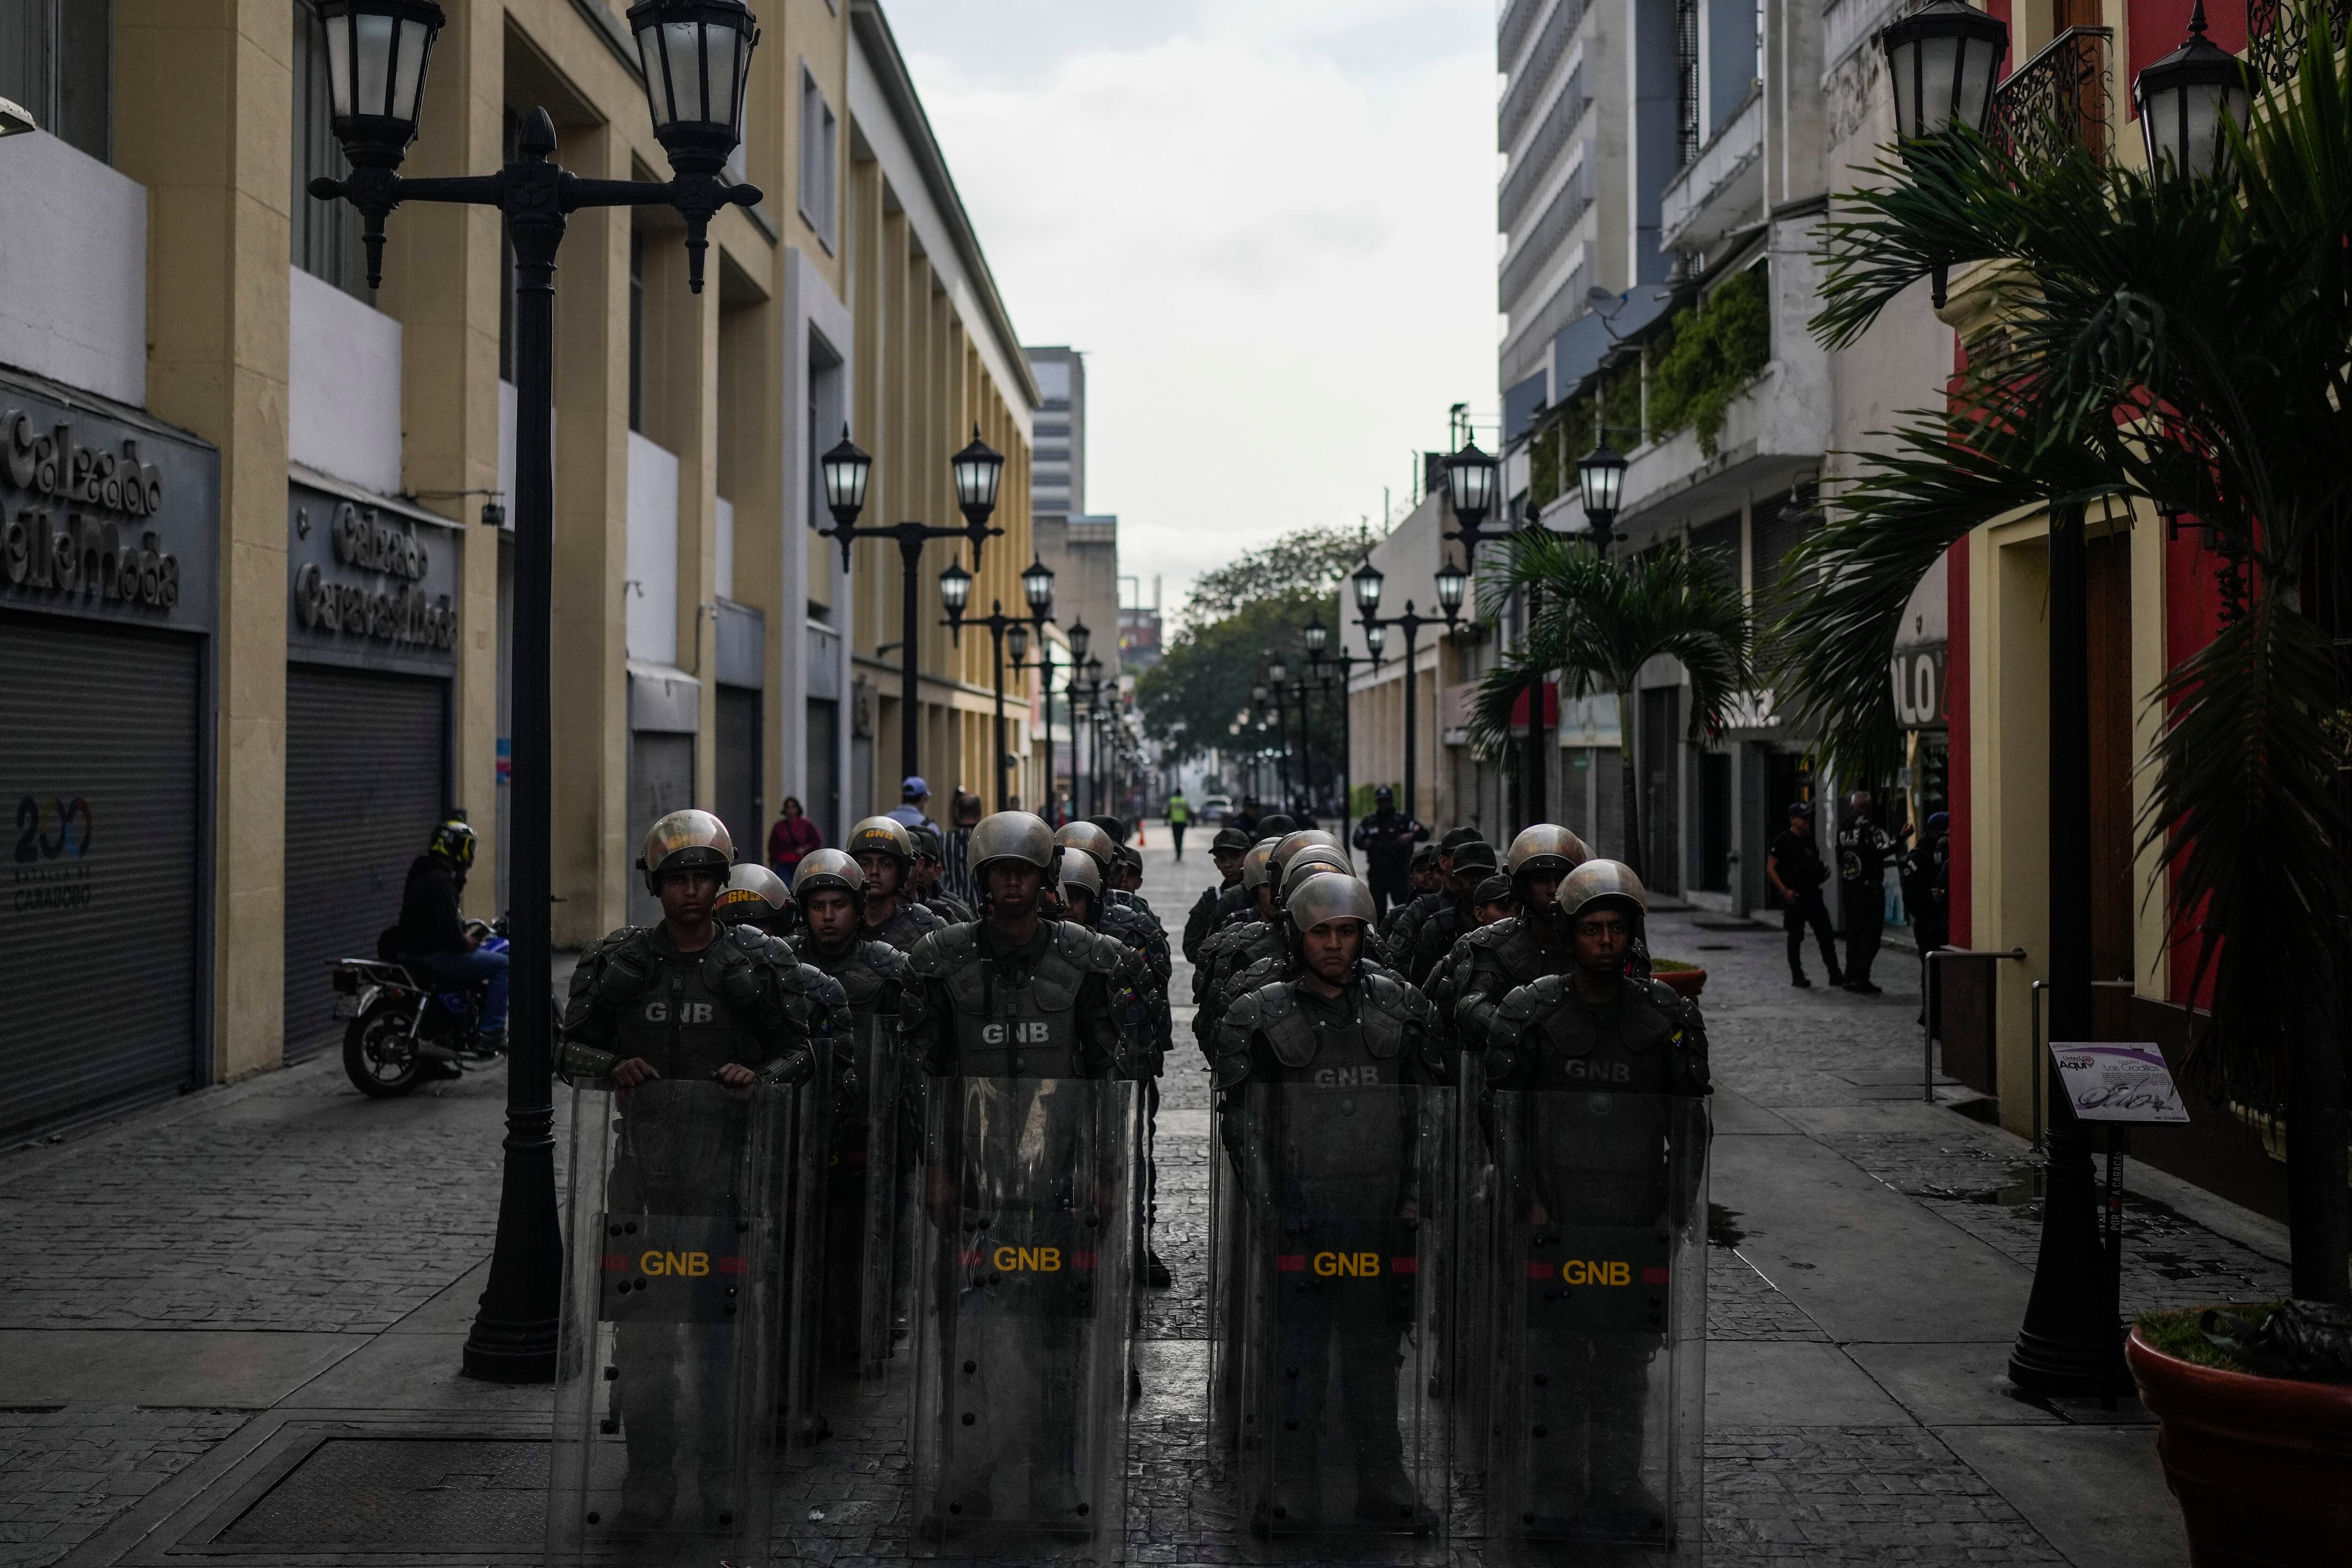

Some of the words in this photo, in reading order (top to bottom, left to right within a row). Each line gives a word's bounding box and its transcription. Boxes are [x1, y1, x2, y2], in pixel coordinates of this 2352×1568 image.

[1, 409, 161, 516] Calzado
[332, 501, 428, 581] Calzado
[15, 796, 92, 863] 200
[866, 830, 893, 841] GNB
[1314, 1065, 1379, 1088] GNB
[1565, 1059, 1630, 1083] GNB
[2121, 1063, 2160, 1072] Gradillas
[2112, 1150, 2122, 1188] CARACAS
[2110, 1214, 2121, 1231] POR
[640, 1250, 710, 1276] GNB
[993, 1247, 1061, 1271] GNB
[1313, 1251, 1381, 1276] GNB
[1562, 1260, 1631, 1286] GNB
